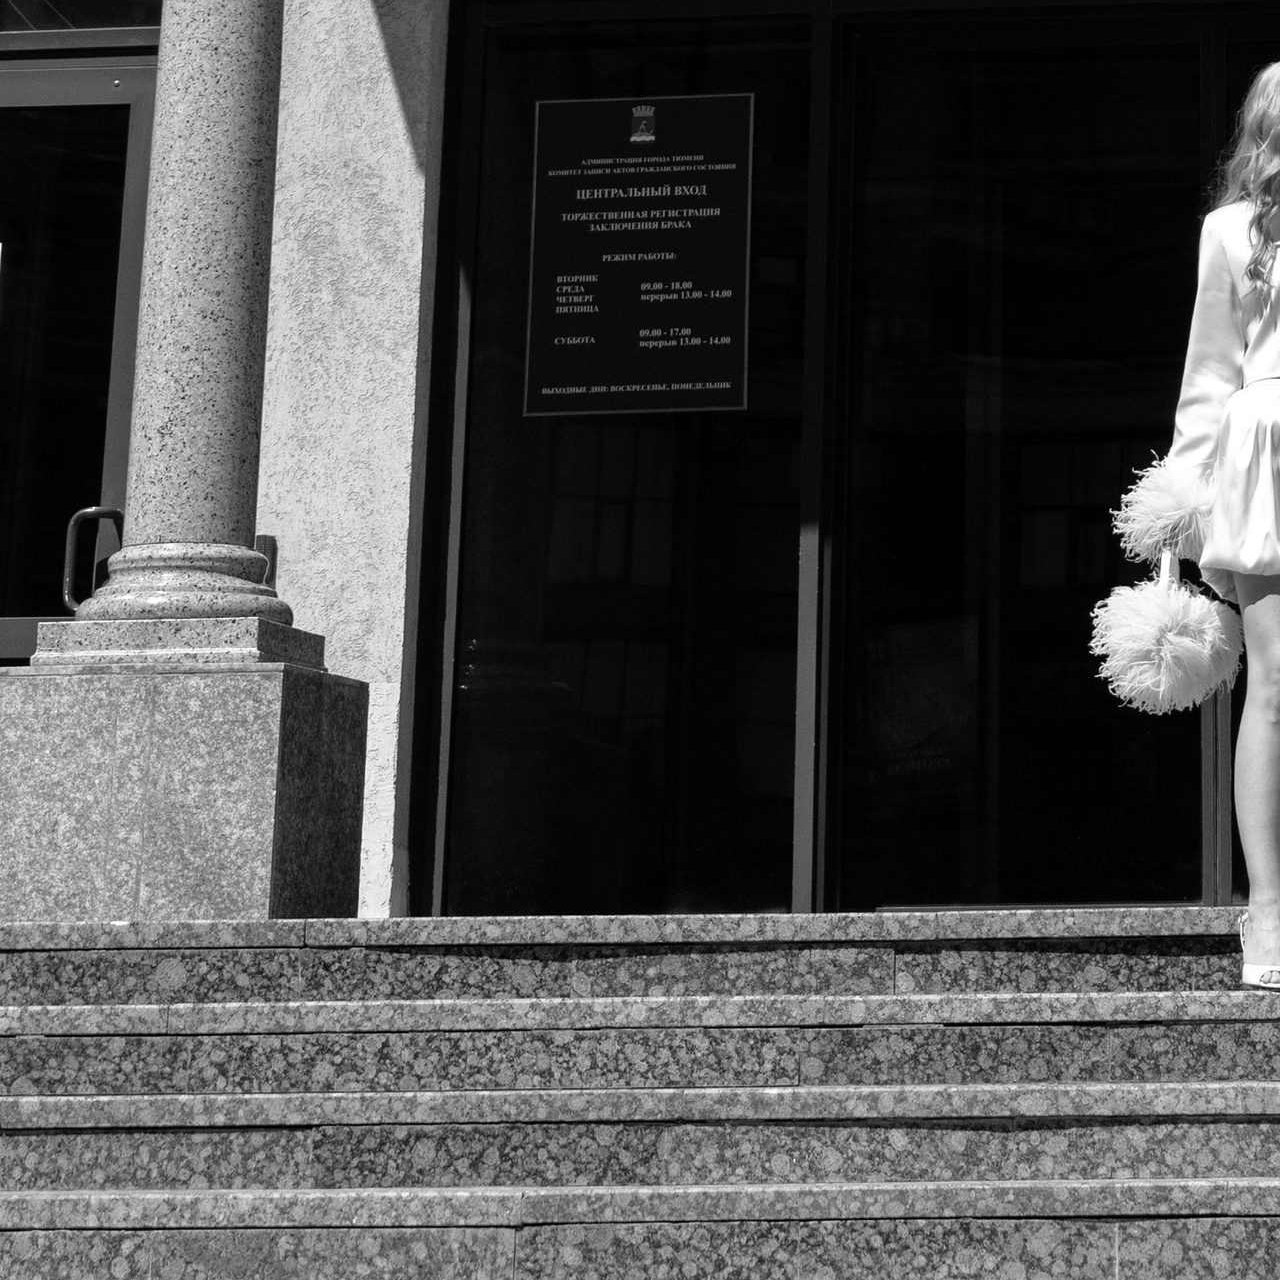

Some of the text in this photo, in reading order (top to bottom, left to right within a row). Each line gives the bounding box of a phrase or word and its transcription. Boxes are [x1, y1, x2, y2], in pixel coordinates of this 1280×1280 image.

[693, 163, 736, 171] СОСТОЯНИЯ
[576, 184, 707, 200] ЦЕНТРАЛЬНЫЙ ВХОД
[561, 208, 720, 221] ТОРЖЕСТВЕННАЯ РЕГИСТРАЦИЯ
[590, 220, 692, 232] ЗАКЛЮЧЕНИЯ БРАКА
[602, 252, 676, 262] РЕЖИМ РАБОТЫ:
[557, 274, 598, 283] ВТОРНИК
[556, 285, 585, 293] СРЕДА
[640, 282, 663, 291] 09.00
[671, 281, 693, 290] 18.00
[556, 295, 595, 303] ЧЕТВЕРГ
[640, 292, 678, 301] перерыв
[681, 290, 702, 299] 13.00
[710, 290, 732, 298] 14.00
[556, 305, 599, 314] ПЯТНИЦА
[639, 329, 662, 337] 09.00
[670, 328, 691, 336] 17.00
[554, 336, 595, 345] СУББОТА
[639, 340, 677, 349] перерыв
[680, 337, 701, 346] 13.00
[709, 336, 731, 345] 14.00
[542, 386, 588, 394] ВЫХОДНЫЕ
[671, 382, 732, 390] ПОНЕДЕЛЬНИК
